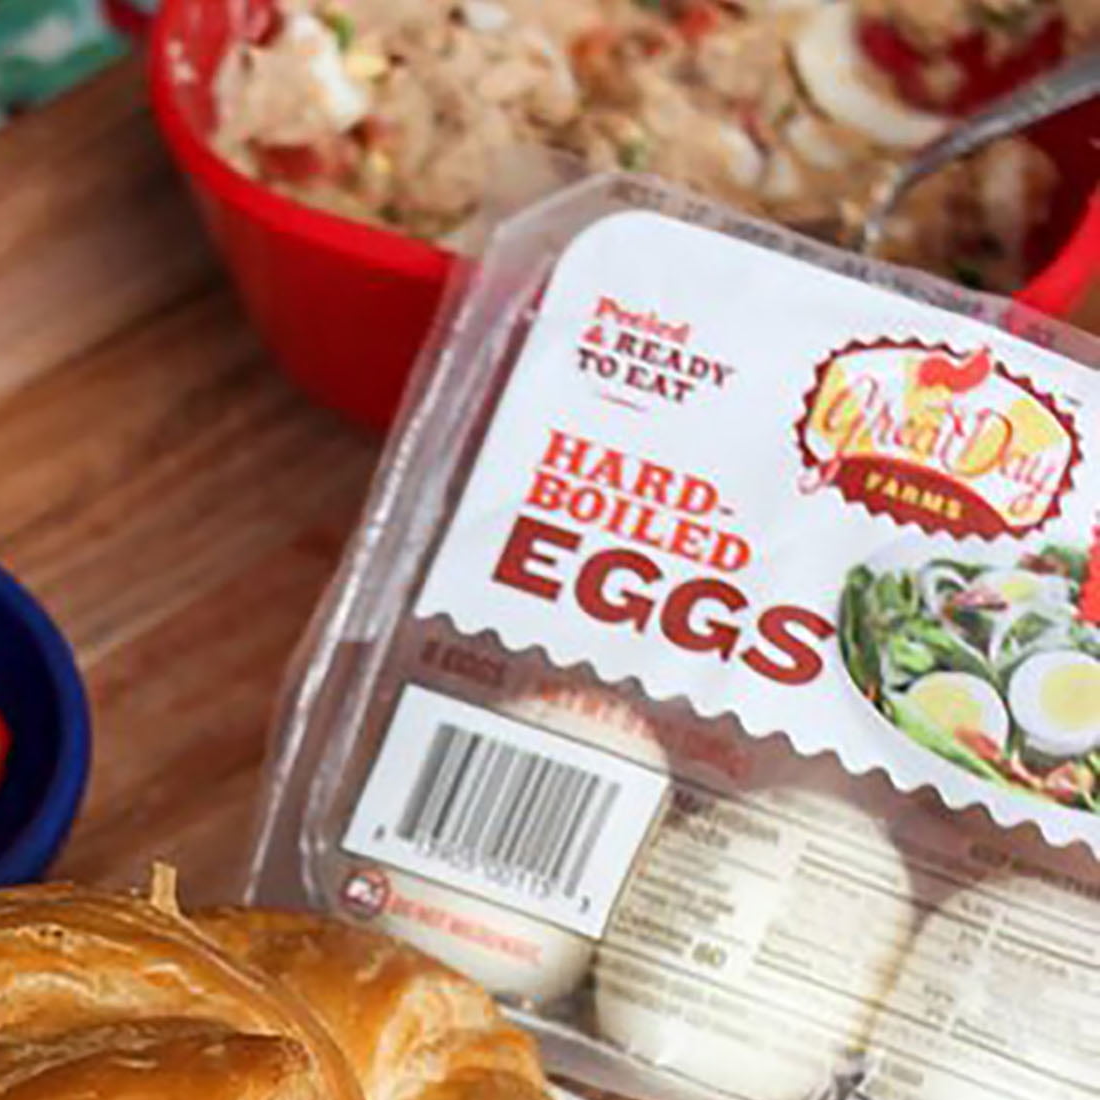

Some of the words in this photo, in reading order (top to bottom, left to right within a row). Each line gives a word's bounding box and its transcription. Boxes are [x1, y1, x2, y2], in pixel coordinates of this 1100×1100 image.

[596, 296, 690, 344] Peeled
[578, 347, 618, 378] TO
[626, 364, 695, 403] EAT
[615, 330, 735, 388] READY
[541, 427, 734, 517] HARD-
[797, 371, 964, 495] Great
[938, 406, 1062, 521] Day
[524, 470, 753, 573] BOILED
[863, 470, 962, 520] FARMS
[491, 513, 837, 687] EGGS
